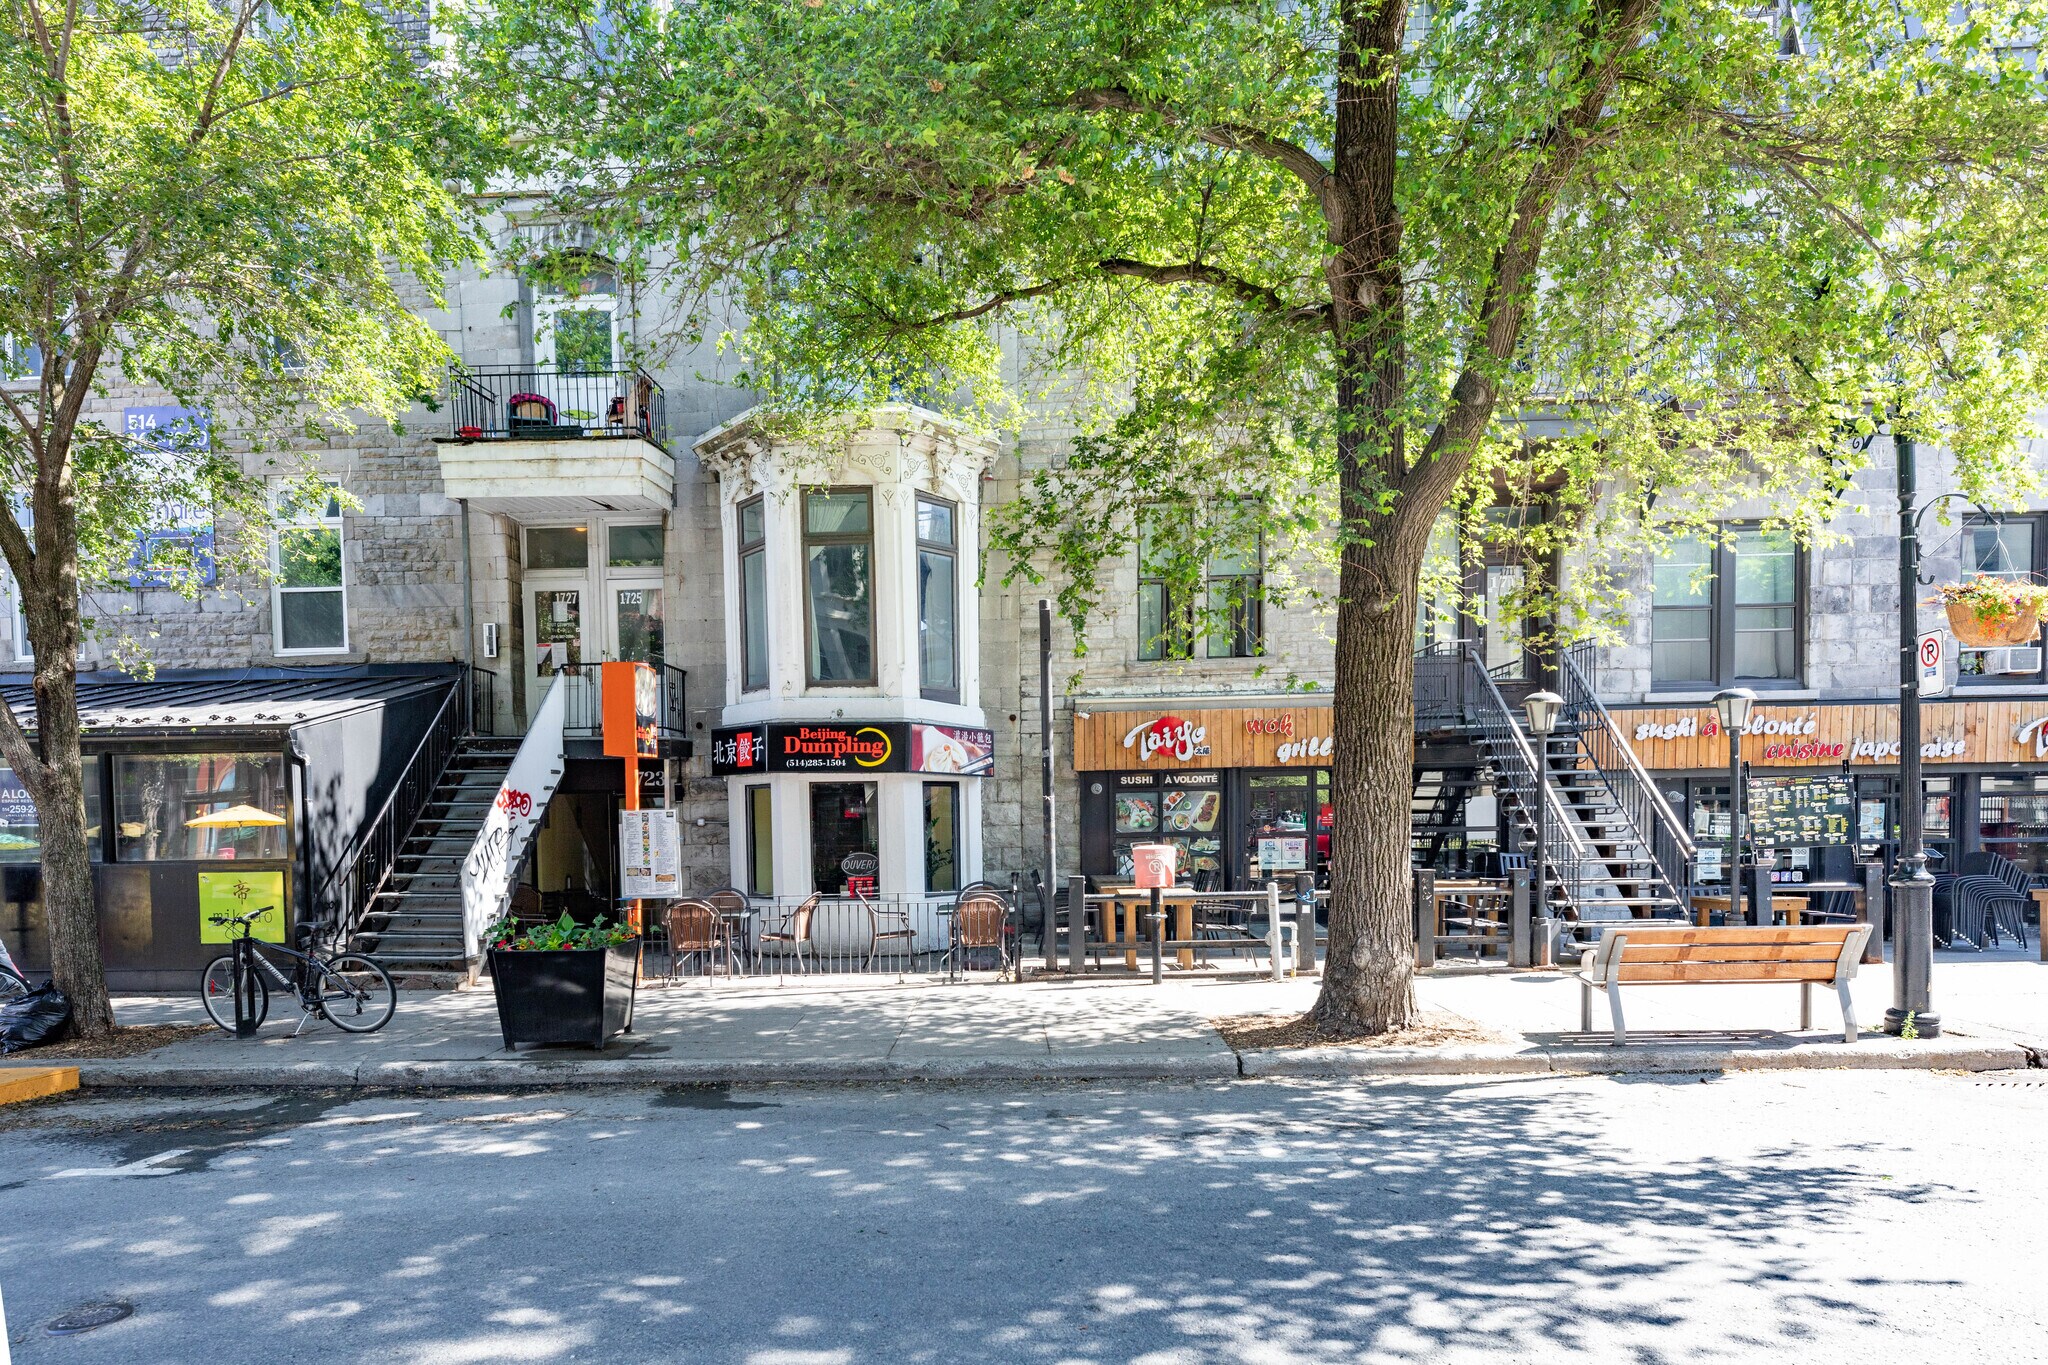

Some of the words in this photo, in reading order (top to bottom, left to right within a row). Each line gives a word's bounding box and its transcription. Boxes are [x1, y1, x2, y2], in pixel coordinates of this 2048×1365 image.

[127, 414, 157, 430] 514
[555, 592, 577, 604] 1727
[620, 592, 642, 604] 1725
[1246, 713, 1294, 737] wok
[1635, 717, 1697, 740] sushi
[1702, 715, 1719, 737] à
[1726, 713, 1817, 736] olonté
[800, 728, 847, 742] Beijing
[1124, 720, 1206, 761] Taiyo
[784, 735, 884, 758] Dumpling
[1766, 738, 1845, 760] cuisine
[1850, 738, 1966, 761] japoaise
[786, 759, 846, 768] (514)285-1504
[1120, 776, 1153, 785] SUSHI
[1165, 775, 1172, 784] À
[1173, 774, 1218, 784] VOLONTÉ
[843, 859, 876, 870] OUVERT
[213, 909, 273, 923] mikdo
